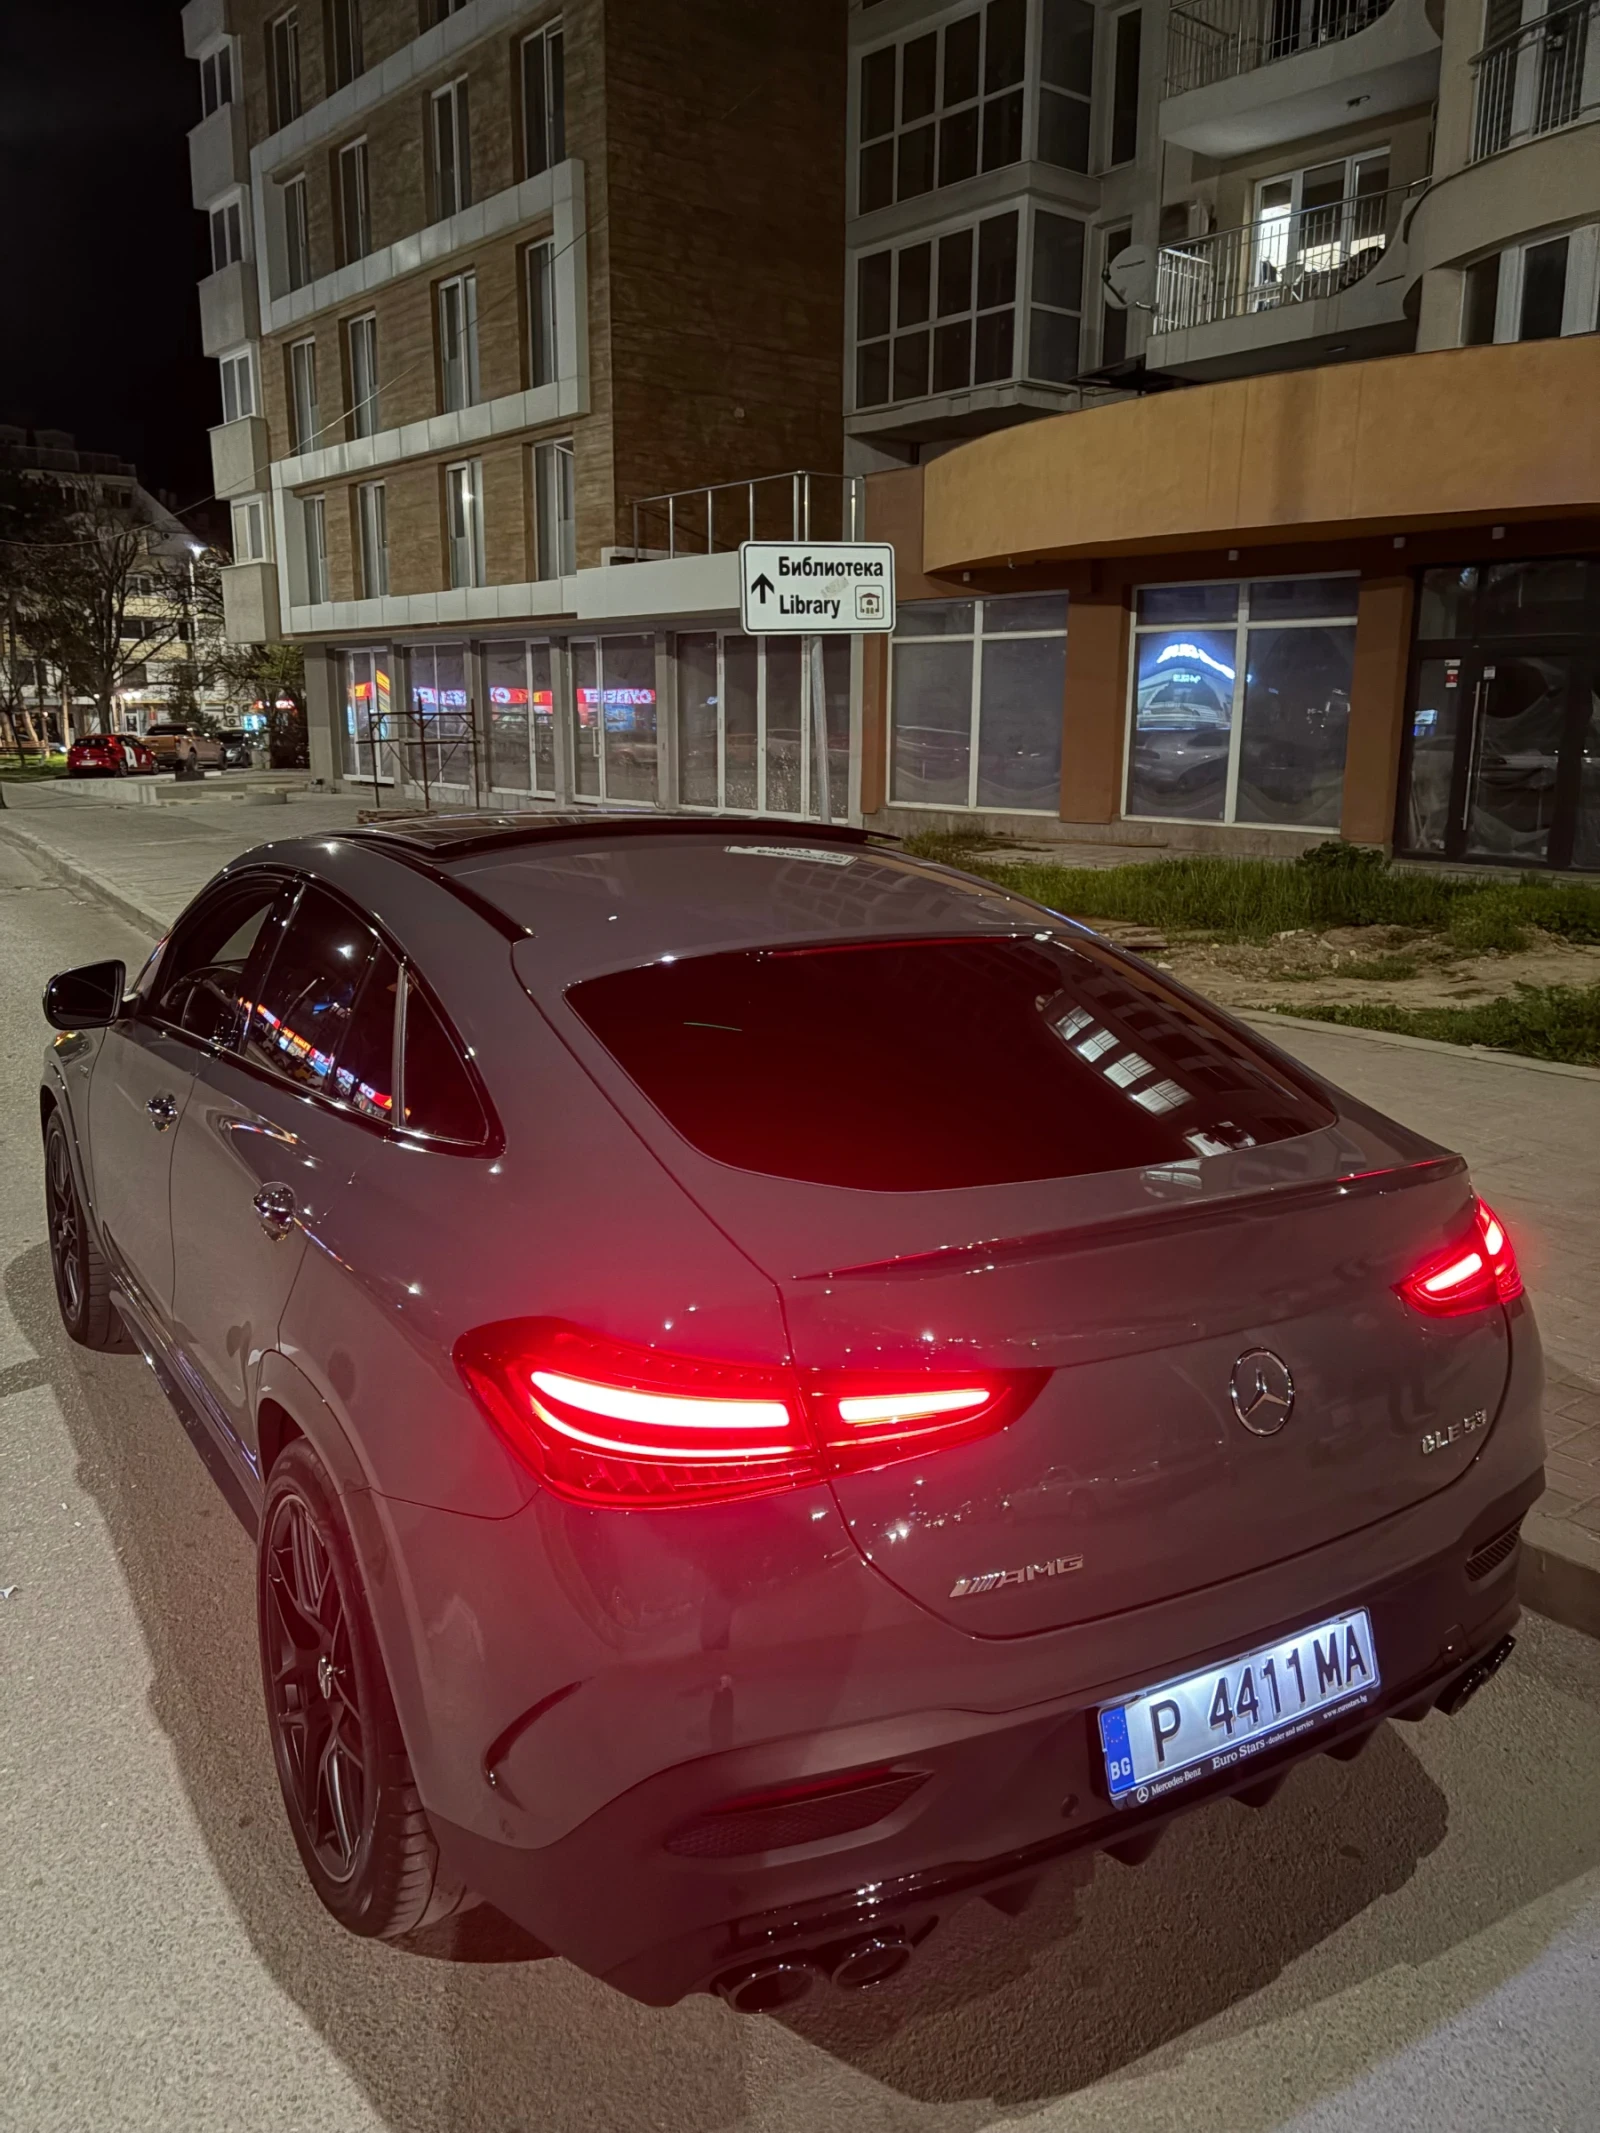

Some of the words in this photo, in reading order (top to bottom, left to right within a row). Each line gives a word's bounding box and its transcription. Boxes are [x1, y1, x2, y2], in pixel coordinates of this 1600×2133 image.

[778, 556, 884, 577] Библиотека
[780, 594, 841, 619] Library
[1421, 1423, 1461, 1454] GLE
[1463, 1408, 1487, 1434] 53
[992, 1553, 1084, 1589] AMG
[1150, 1698, 1182, 1763] P
[1208, 1647, 1307, 1736] 4411
[1312, 1624, 1368, 1696] MA
[1110, 1756, 1132, 1781] BG
[1150, 1767, 1202, 1796] Mercedes-Benz
[1211, 1751, 1238, 1770] Euro
[1238, 1739, 1266, 1758] Stars
[1285, 1726, 1296, 1738] and
[1296, 1719, 1315, 1733] service
